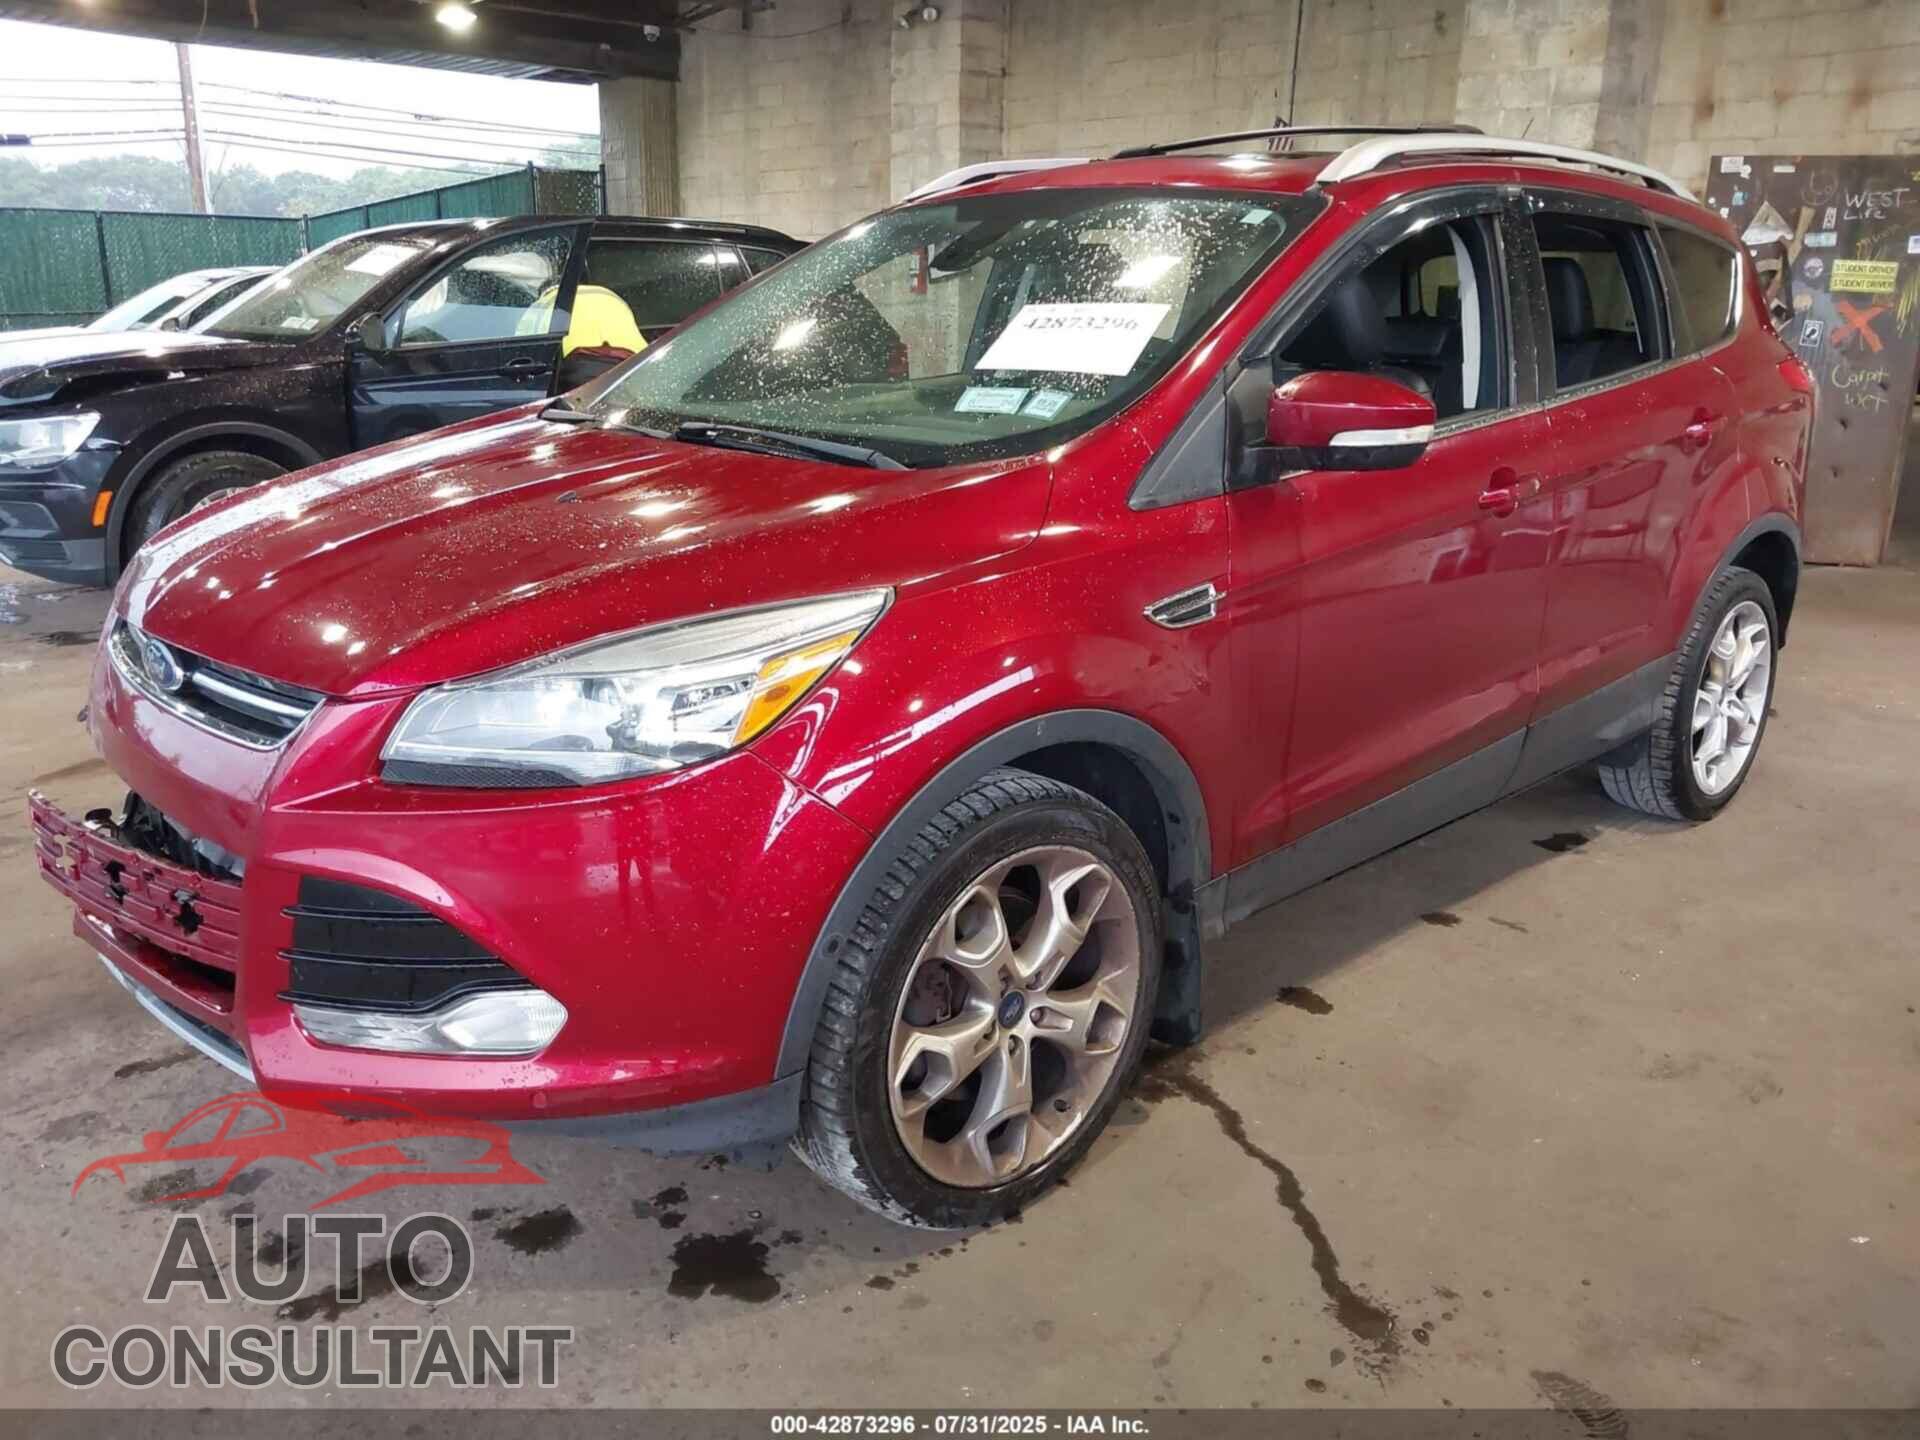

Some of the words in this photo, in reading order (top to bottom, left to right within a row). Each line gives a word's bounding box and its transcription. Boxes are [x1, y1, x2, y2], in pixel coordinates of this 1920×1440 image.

[1844, 187, 1911, 208] WEST
[1836, 263, 1868, 273] STUDENT
[1833, 279, 1865, 289] STUDENT
[1866, 280, 1894, 289] DRIVER
[1024, 317, 1139, 329] 42873296
